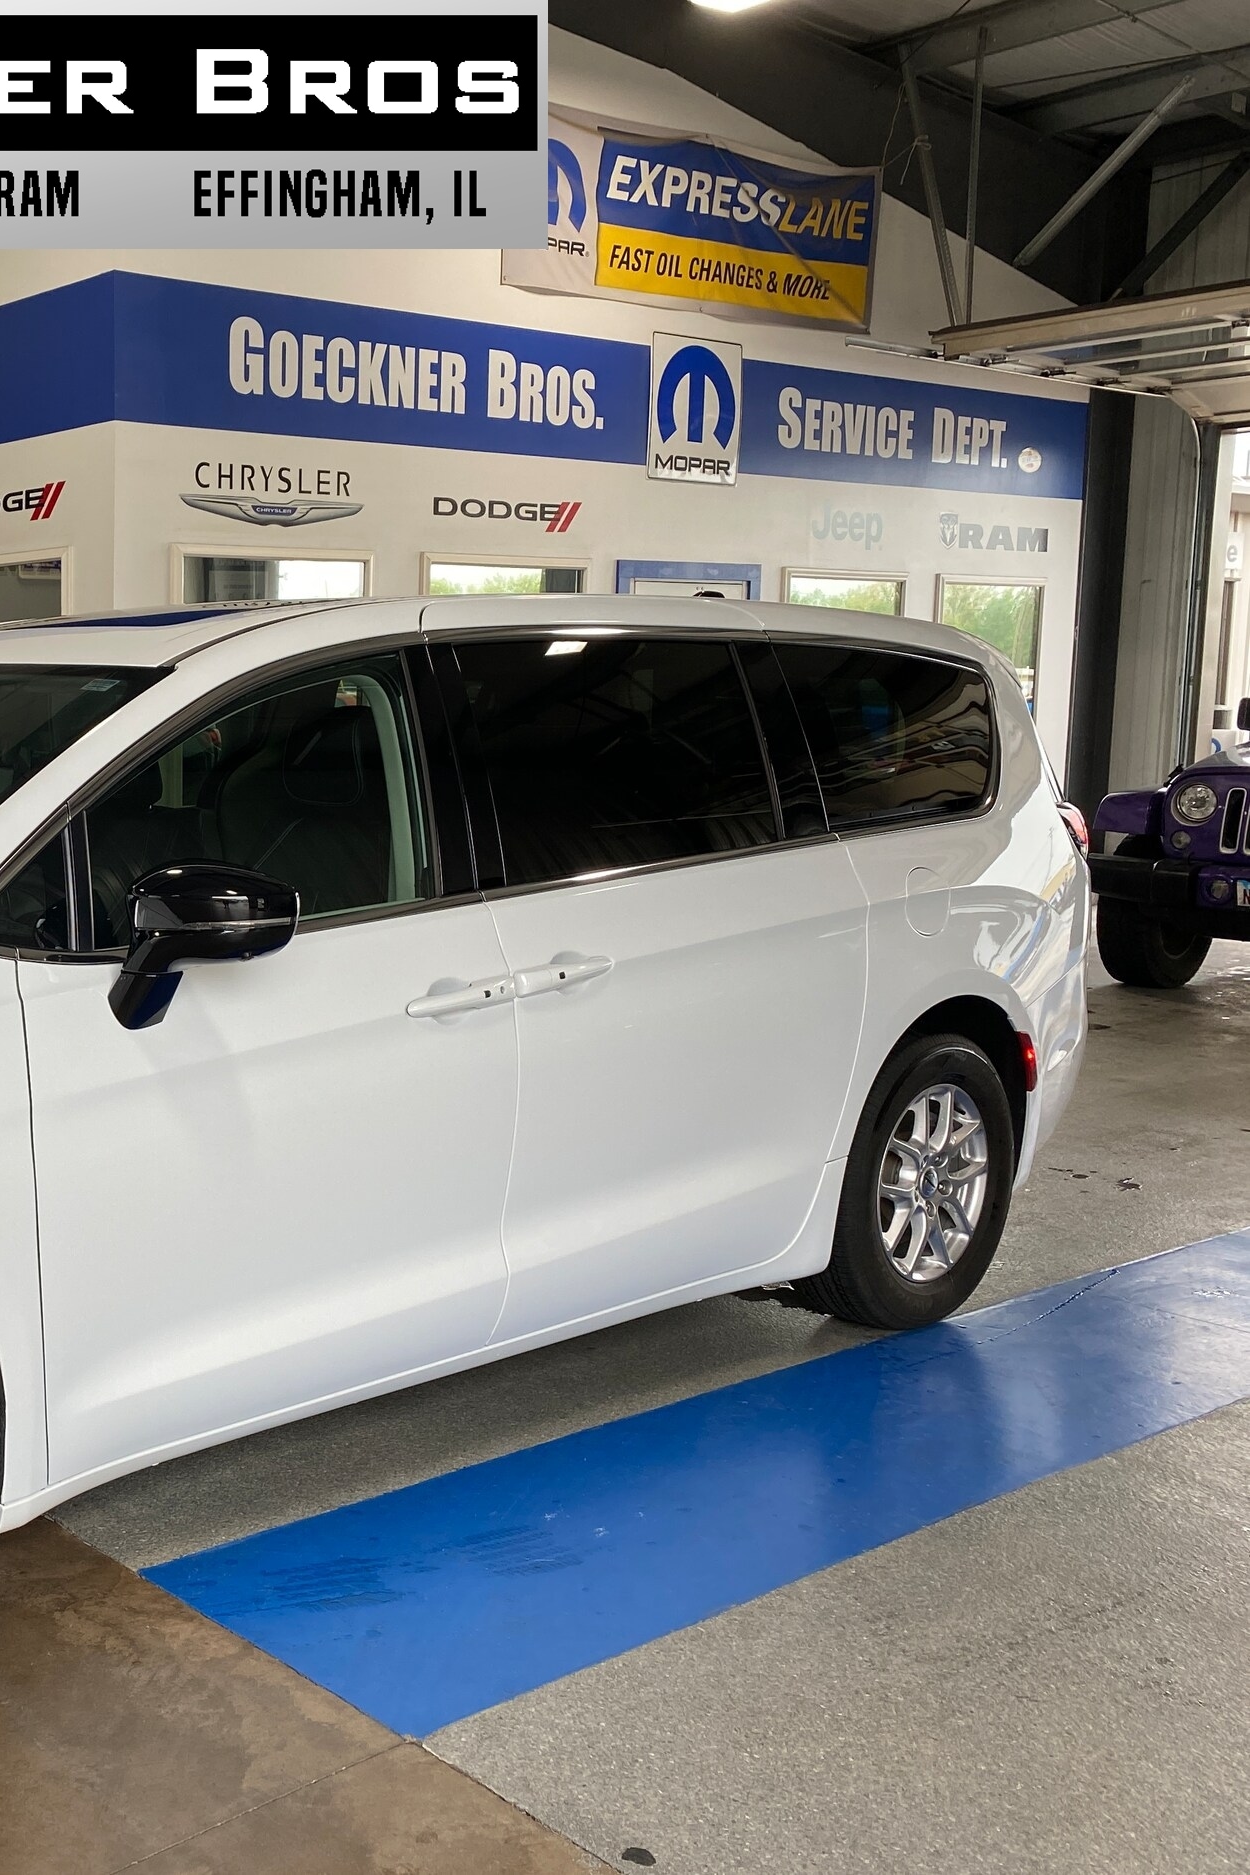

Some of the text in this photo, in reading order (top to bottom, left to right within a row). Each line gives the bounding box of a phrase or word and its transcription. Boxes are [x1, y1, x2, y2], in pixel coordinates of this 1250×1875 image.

[606, 155, 869, 241] EXPRESSLANE
[609, 244, 830, 300] FAST OIL CHANGES & MORE
[228, 316, 605, 430] GOECKNER BROS.
[777, 386, 1008, 469] SERVICE DEPT.
[194, 461, 351, 497] CHRYSLER
[654, 452, 731, 477] MOPAR
[433, 496, 563, 522] DODGE
[811, 503, 882, 550] Jeep
[958, 523, 1049, 553] RAM
